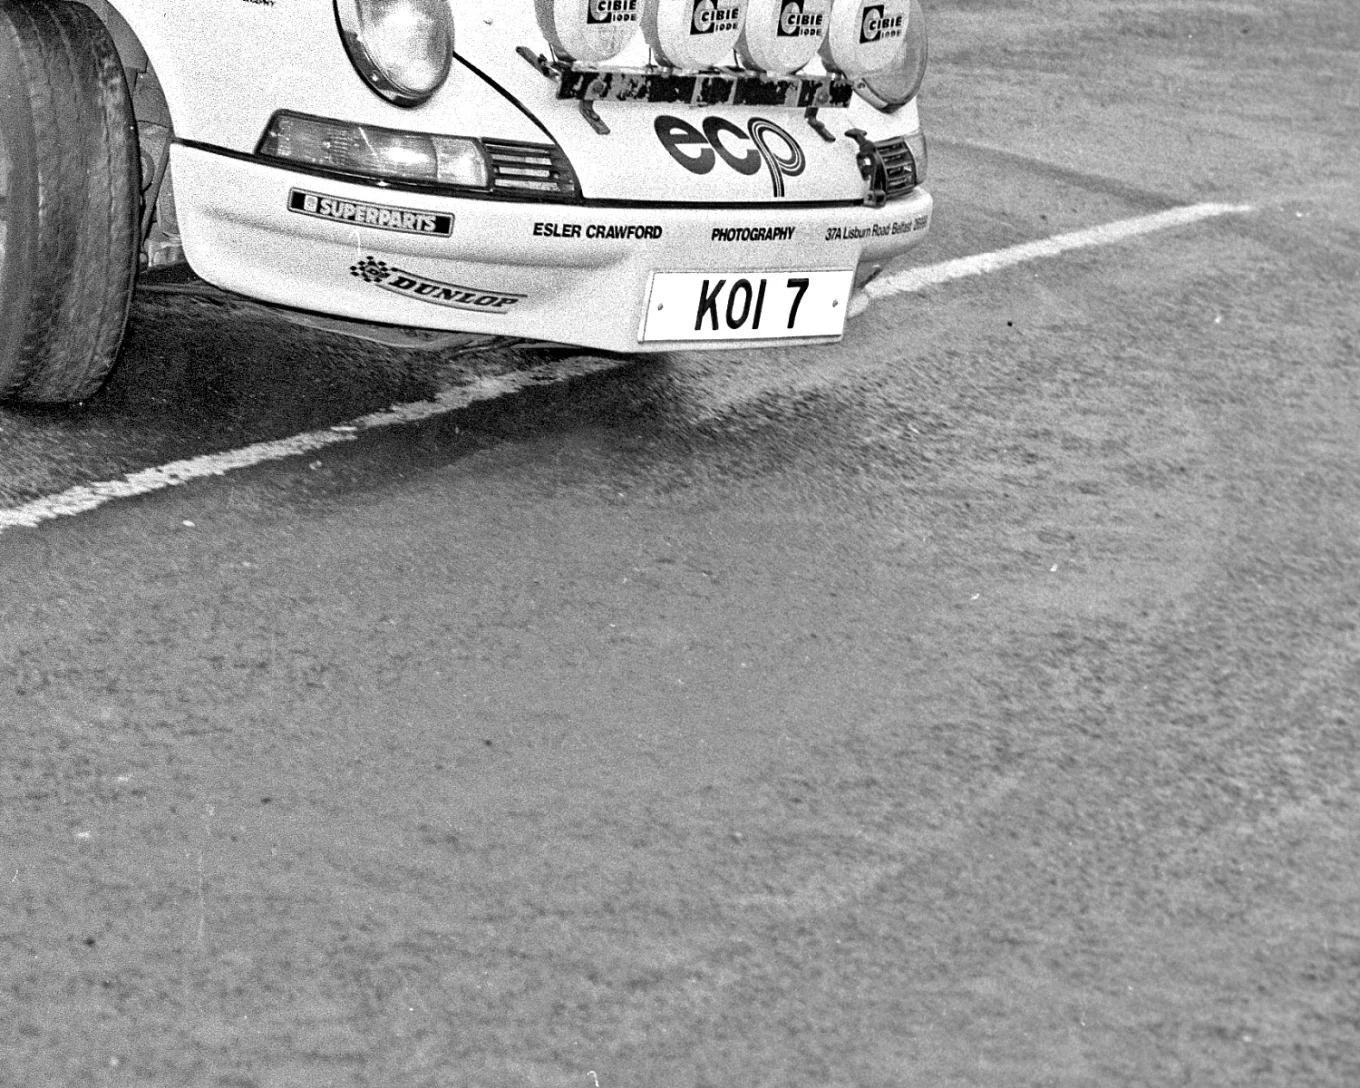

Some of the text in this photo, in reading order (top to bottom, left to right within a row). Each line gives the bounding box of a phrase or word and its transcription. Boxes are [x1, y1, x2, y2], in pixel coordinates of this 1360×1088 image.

[597, 0, 637, 11] CIBIE
[701, 8, 739, 22] CIBIE
[787, 14, 823, 25] CIBIE
[869, 16, 902, 31] CIBIE
[654, 115, 806, 198] ecp
[319, 198, 437, 233] SUPERPARTS
[533, 222, 582, 239] ESLER
[585, 224, 663, 240] CRAWFORD
[711, 226, 795, 242] PHOTOGRAPHY
[825, 227, 841, 241] 37A
[843, 225, 871, 240] Lisburn
[871, 223, 890, 237] Road
[390, 274, 519, 308] DUNLOP
[694, 278, 809, 331] KOI 7
